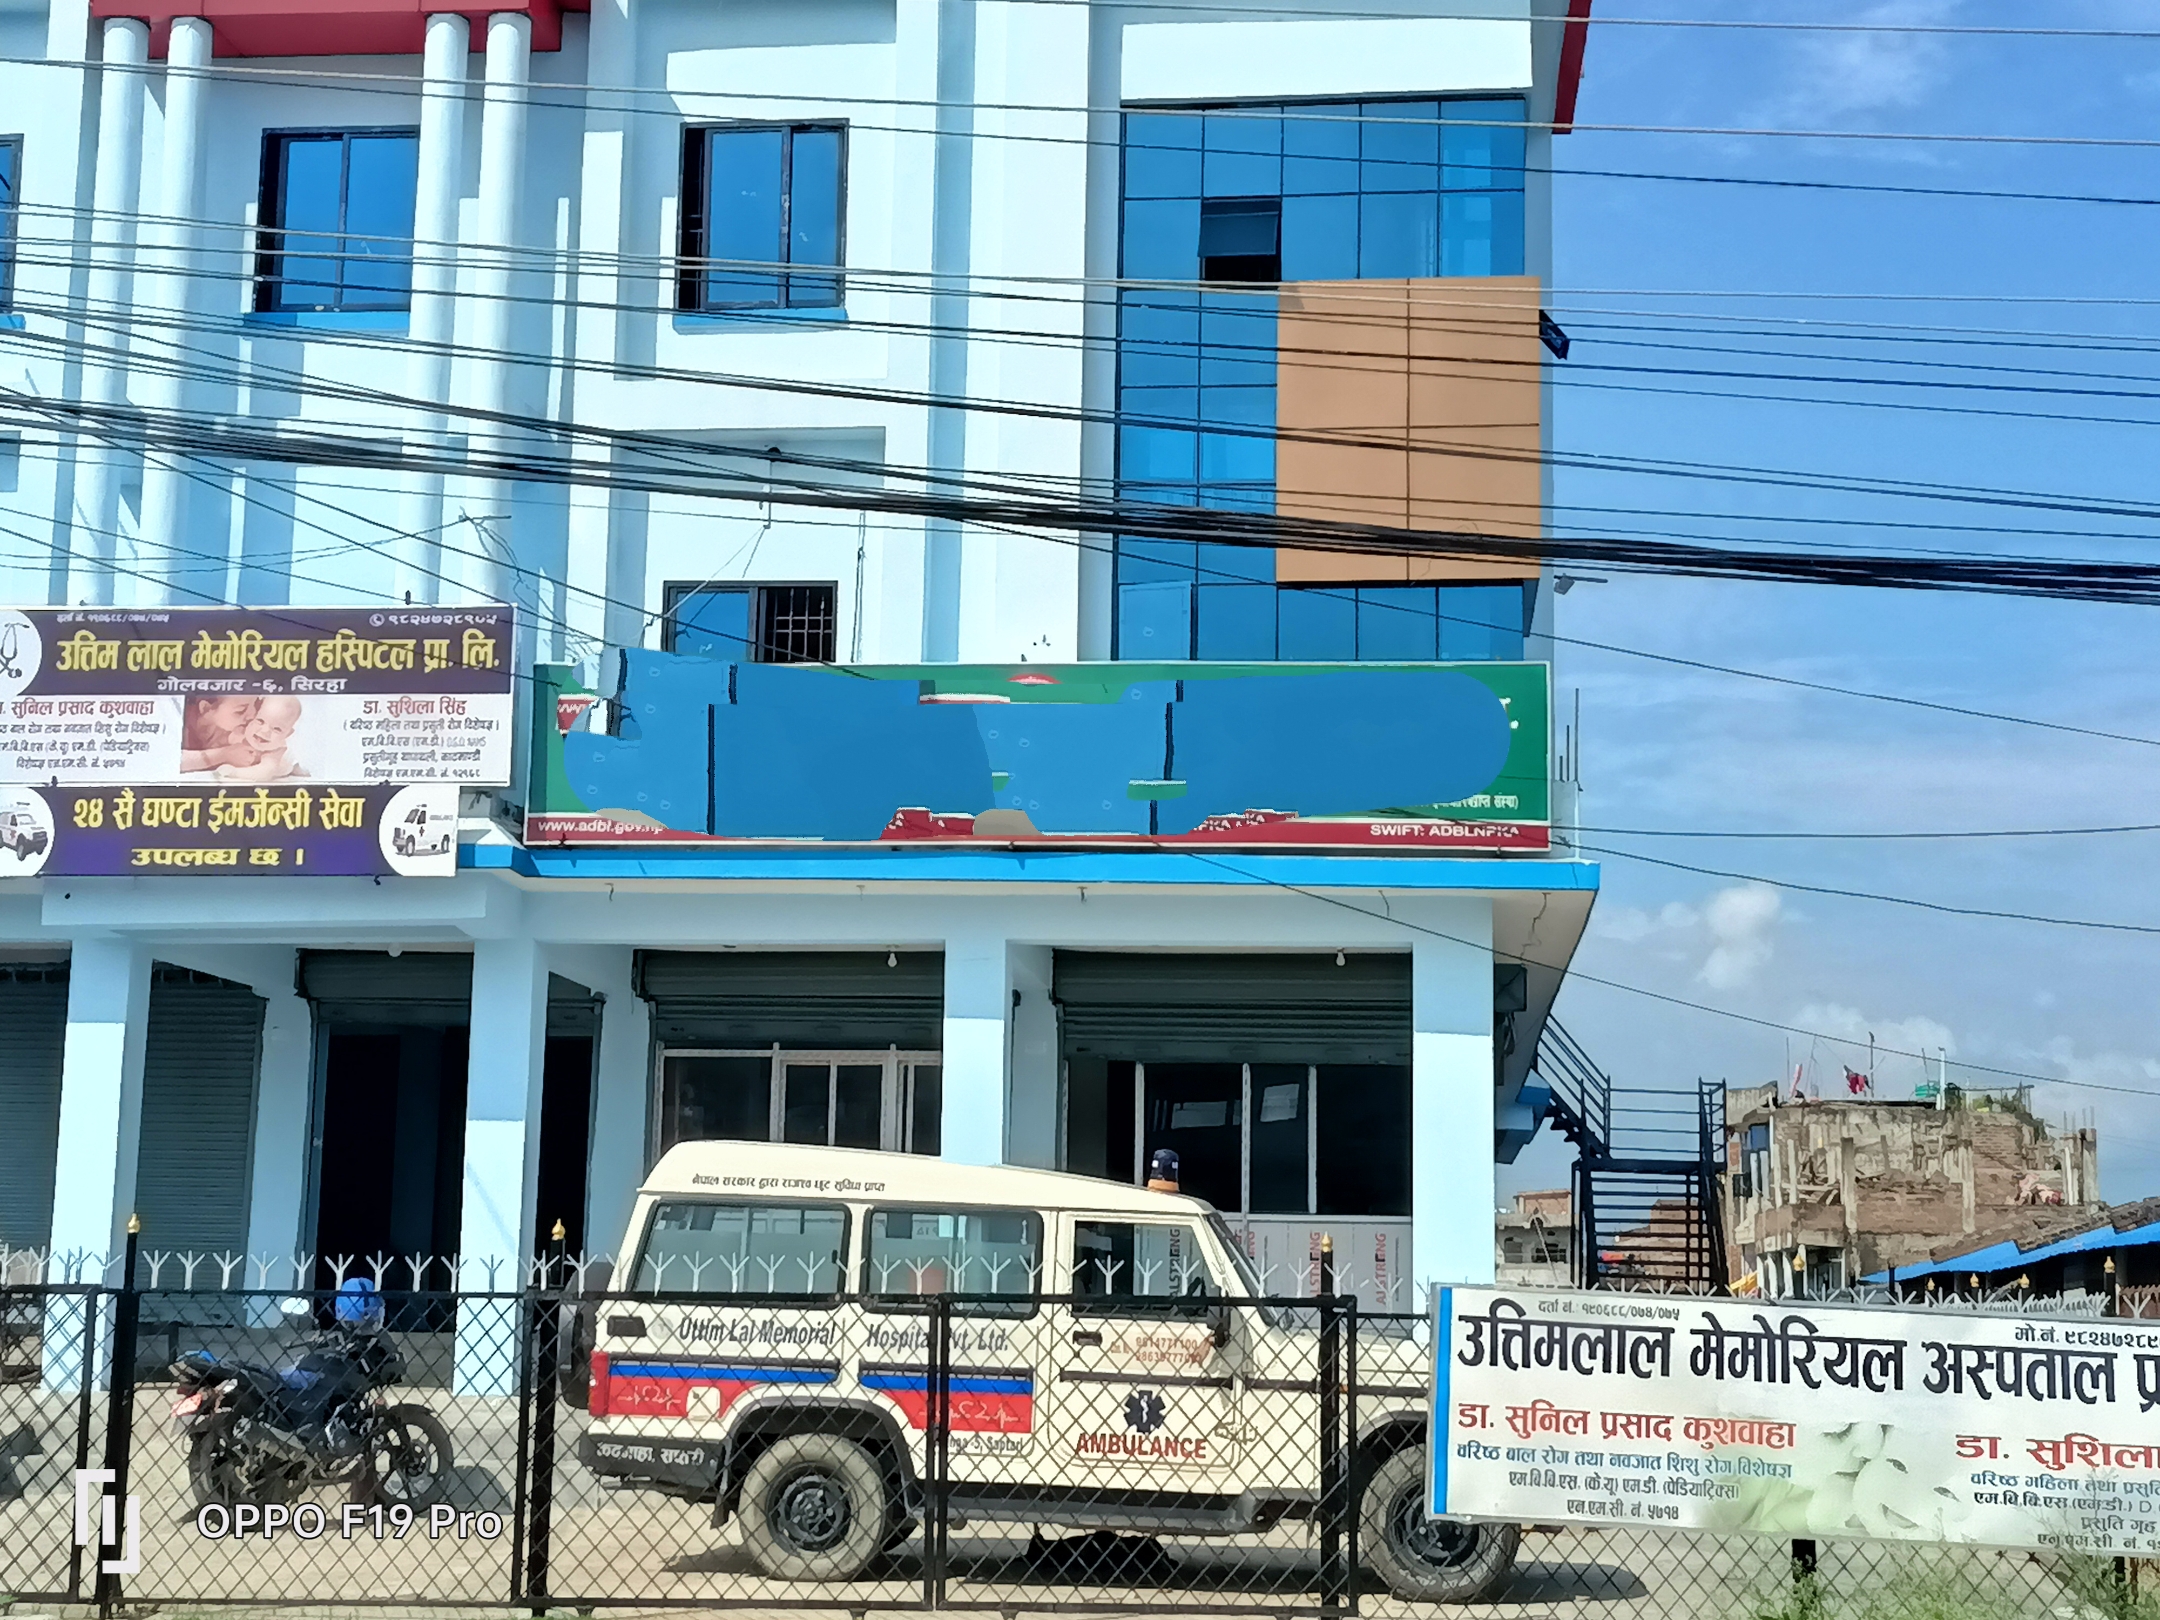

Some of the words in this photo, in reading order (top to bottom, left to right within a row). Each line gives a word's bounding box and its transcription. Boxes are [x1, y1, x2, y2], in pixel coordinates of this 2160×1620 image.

[56, 629, 121, 671] उत्तिम
[127, 639, 185, 671] लाल
[191, 629, 310, 672] मेमोरियल
[316, 628, 417, 672] हस्पिटल
[423, 638, 454, 673] प्रा.
[462, 628, 500, 671] लि.
[291, 675, 348, 692] सिरहा
[11, 697, 54, 718] सुनिल
[58, 700, 96, 717] प्रसाद
[99, 700, 155, 718] कुशवाहा
[387, 695, 436, 718] सुशिला
[439, 695, 467, 715] सिंह
[73, 798, 102, 828] २४
[141, 798, 203, 830] घण्टा
[318, 788, 365, 831] सेवा
[1370, 824, 1425, 837] SWIFT:
[249, 847, 282, 867] छ
[692, 1172, 719, 1186] नेपाल
[722, 1176, 756, 1187] सरकार
[1538, 1298, 1559, 1313] दर्ता
[728, 1316, 757, 1342] Lal
[759, 1319, 836, 1346] Memorial
[866, 1322, 930, 1353] Hospita
[978, 1326, 1008, 1351] Ltd.
[1457, 1297, 1675, 1379] उत्तिमलाल
[1690, 1311, 1908, 1394] मेमोरियल
[1921, 1340, 2118, 1405] अस्पताल
[1458, 1402, 1494, 1430] डा.
[1505, 1398, 1591, 1439] सुनिल
[1600, 1411, 1674, 1441] प्रसाद
[1683, 1416, 1797, 1450] कुशवाहा
[1075, 1432, 1207, 1459] AMBULANCE
[1955, 1434, 2009, 1460] डा.
[1457, 1439, 1501, 1461] वरिष्ठ
[1506, 1446, 1536, 1464] बाल
[1541, 1444, 1569, 1465] रोग
[1574, 1451, 1604, 1468] तथा
[1609, 1453, 1661, 1472] नवजात
[1667, 1451, 1699, 1477] शिशु
[1704, 1454, 1732, 1475] रोग
[1738, 1456, 1793, 1479] विशेषज्ञ
[1970, 1470, 2020, 1489] वरिष्ठ
[2025, 1473, 2080, 1492] महिला
[2085, 1478, 2117, 1494] तथा
[1647, 1503, 1680, 1520] ५७१४
